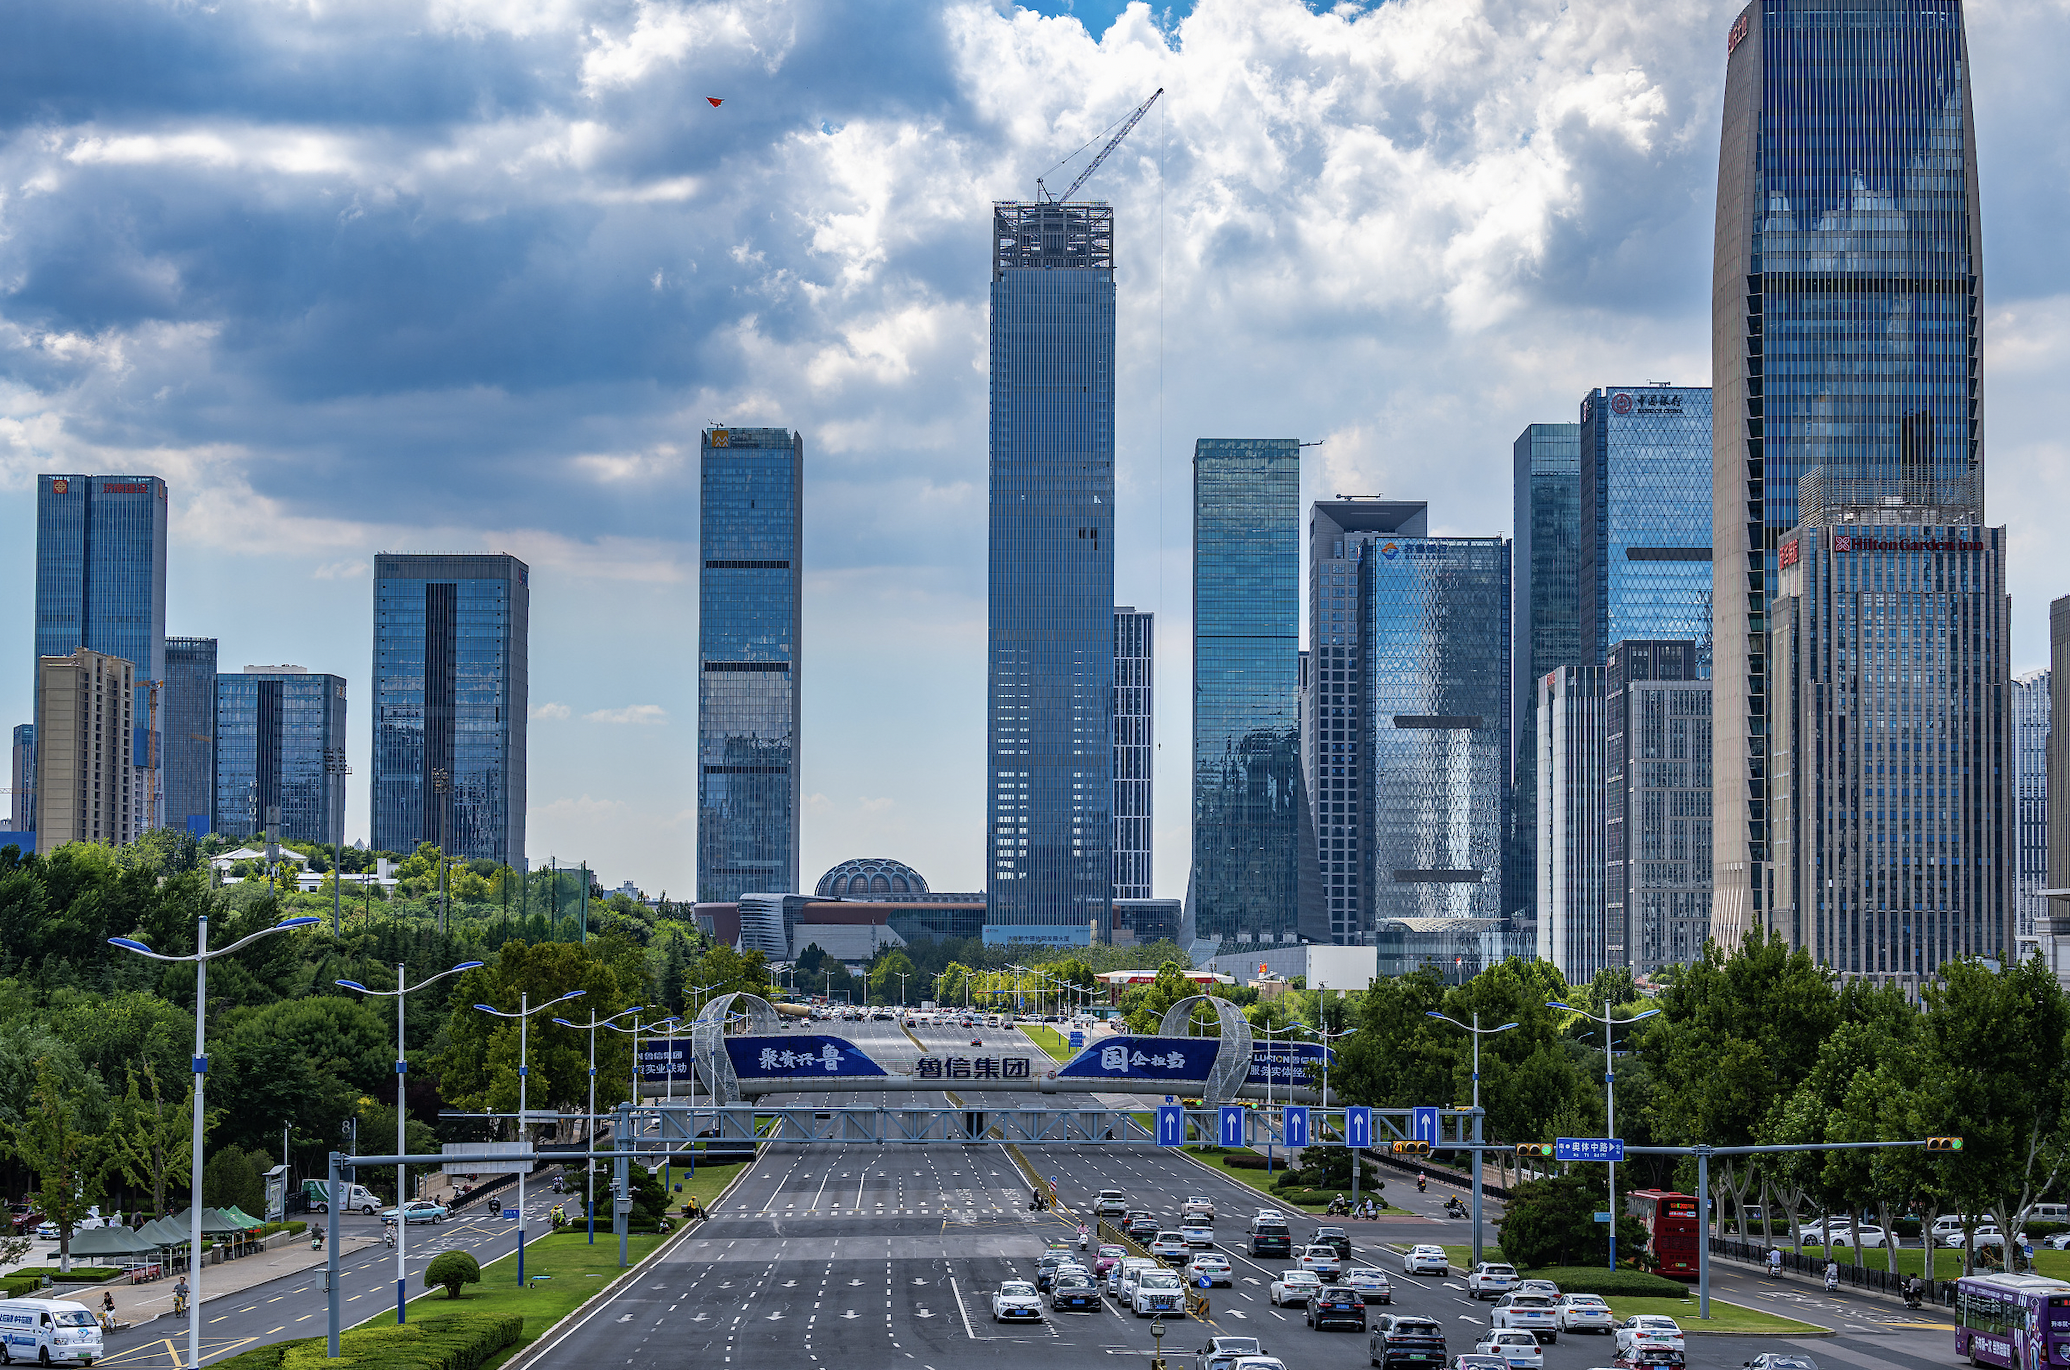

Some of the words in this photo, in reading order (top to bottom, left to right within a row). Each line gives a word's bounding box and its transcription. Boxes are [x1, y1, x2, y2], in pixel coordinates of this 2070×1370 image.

[1851, 538, 1898, 550] Hilton
[1900, 538, 1953, 550] Garden
[1958, 539, 1984, 550] Inn
[758, 1043, 845, 1071] 聚资兴鲁
[915, 1057, 1030, 1079] 鲁信集团
[1101, 1045, 1186, 1073] 国企担当
[1572, 1142, 1608, 1153] 奥体中路
